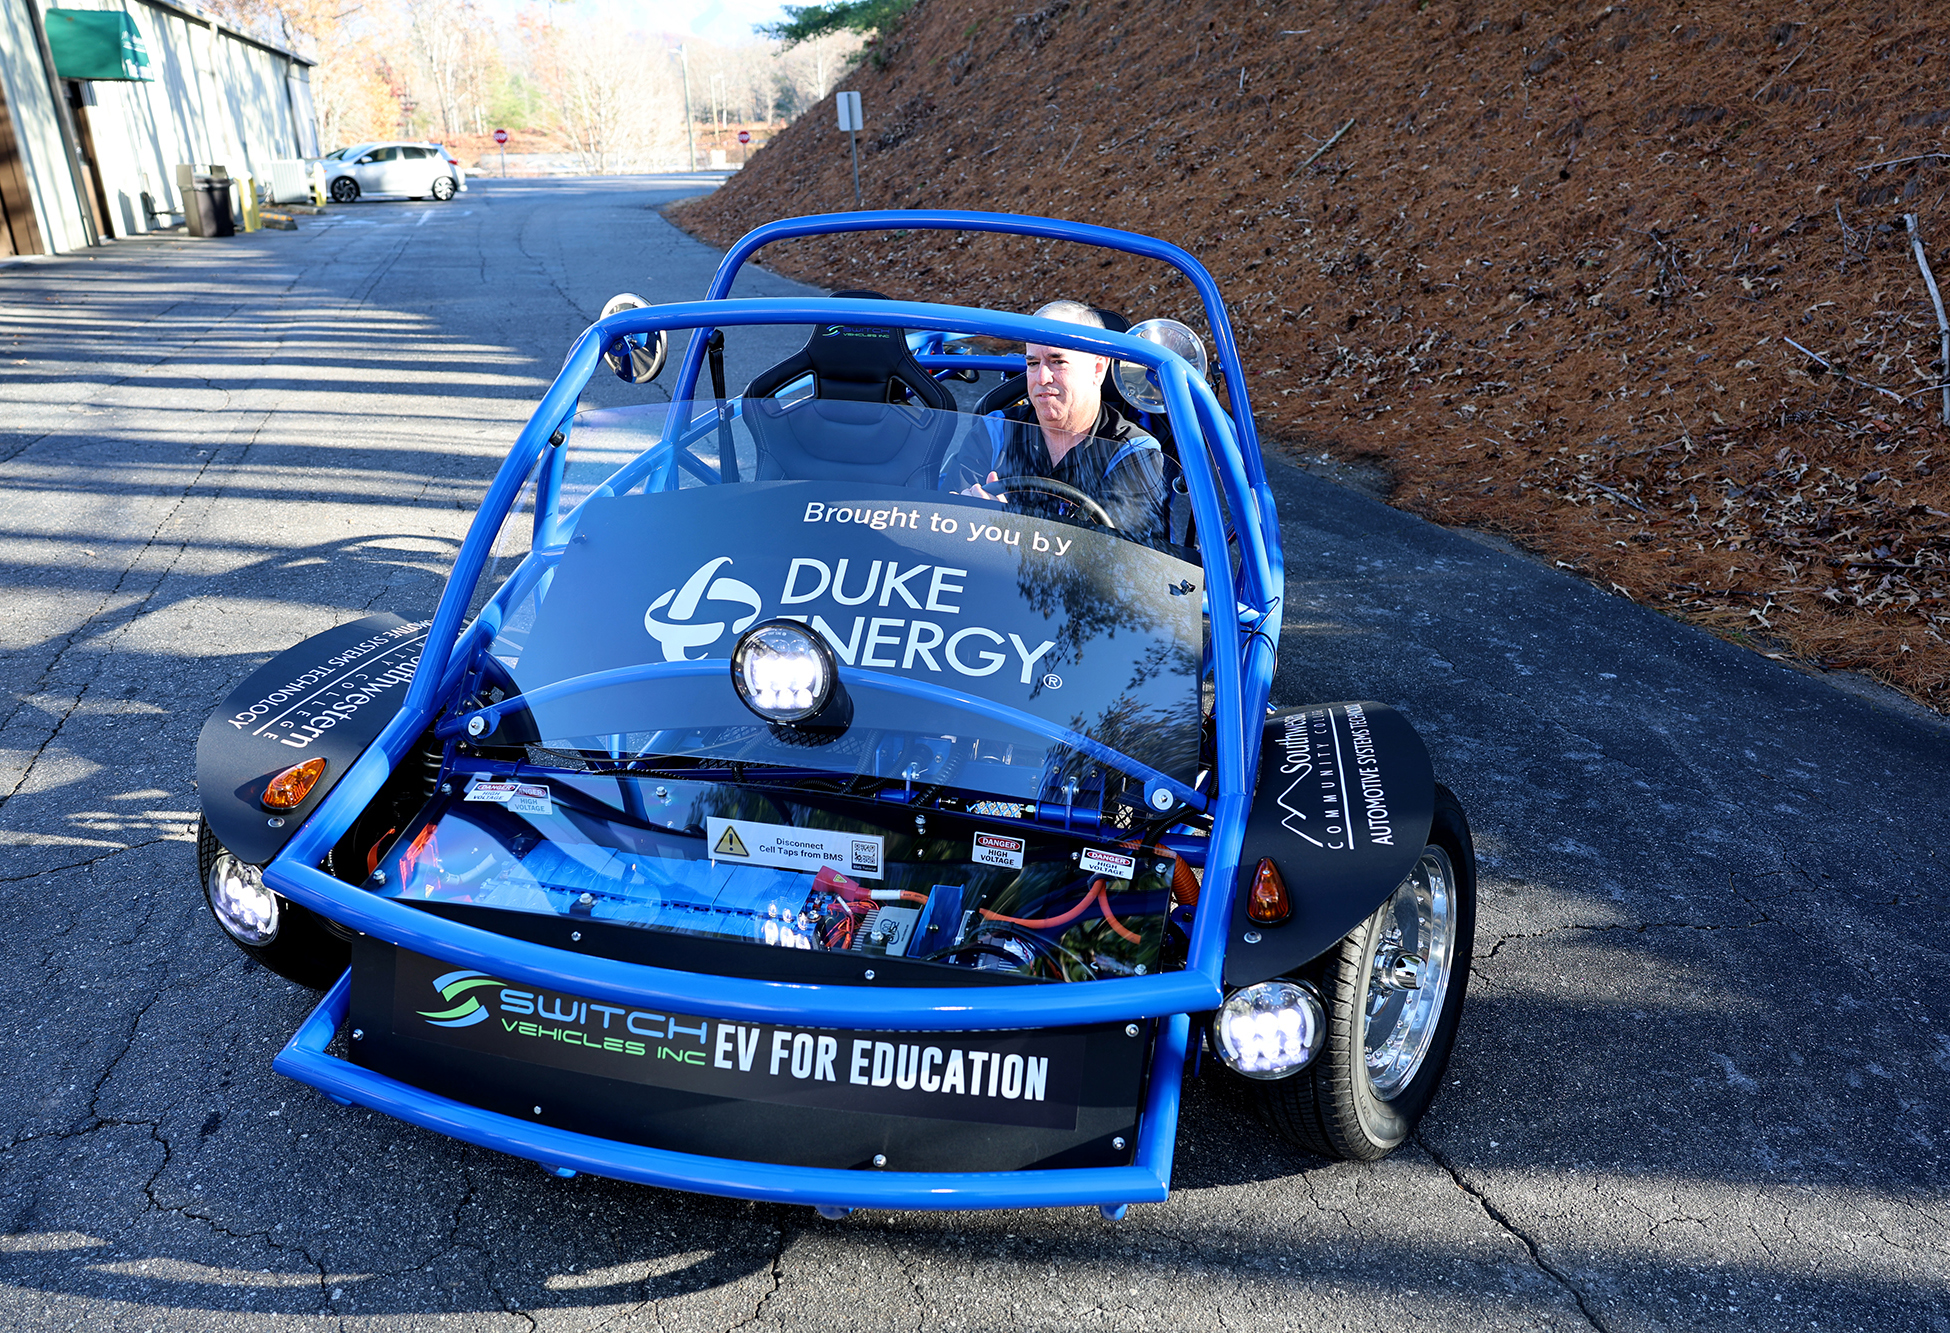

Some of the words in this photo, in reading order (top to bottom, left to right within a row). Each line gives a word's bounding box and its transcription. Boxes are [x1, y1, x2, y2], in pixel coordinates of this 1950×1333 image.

[803, 502, 918, 530] Brought
[930, 512, 958, 535] to
[967, 521, 1021, 546] you
[1033, 531, 1072, 556] by
[780, 557, 967, 614] DUKE
[328, 635, 389, 667] SYSTEMS
[228, 665, 337, 730] TECHNOLOGY
[264, 673, 368, 741] COLLEGE
[281, 654, 421, 748] outhwestern
[1351, 727, 1377, 765] SYSTEMS
[515, 804, 545, 812] VOLTAGE
[1316, 743, 1344, 850] COMMUNITY
[1359, 767, 1394, 845] AUTOMOTIVE
[759, 845, 775, 854] Cell
[778, 847, 798, 857] Taps
[800, 850, 821, 859] from
[823, 852, 843, 862] BMS
[776, 838, 824, 850] Disconnect
[980, 855, 1014, 866] VOLTAGE
[982, 837, 1017, 849] DANGER
[988, 849, 1008, 858] HIGH
[1091, 852, 1126, 865] DANGER
[1089, 864, 1124, 876] VOLTAGE
[1097, 861, 1118, 869] HIGH
[500, 988, 707, 1044] SWITCH
[501, 1018, 646, 1056] VEHICLES
[657, 1046, 707, 1067] INC
[714, 1023, 761, 1072] EV
[770, 1031, 838, 1083] FOR
[849, 1041, 1050, 1101] EDUCATION
